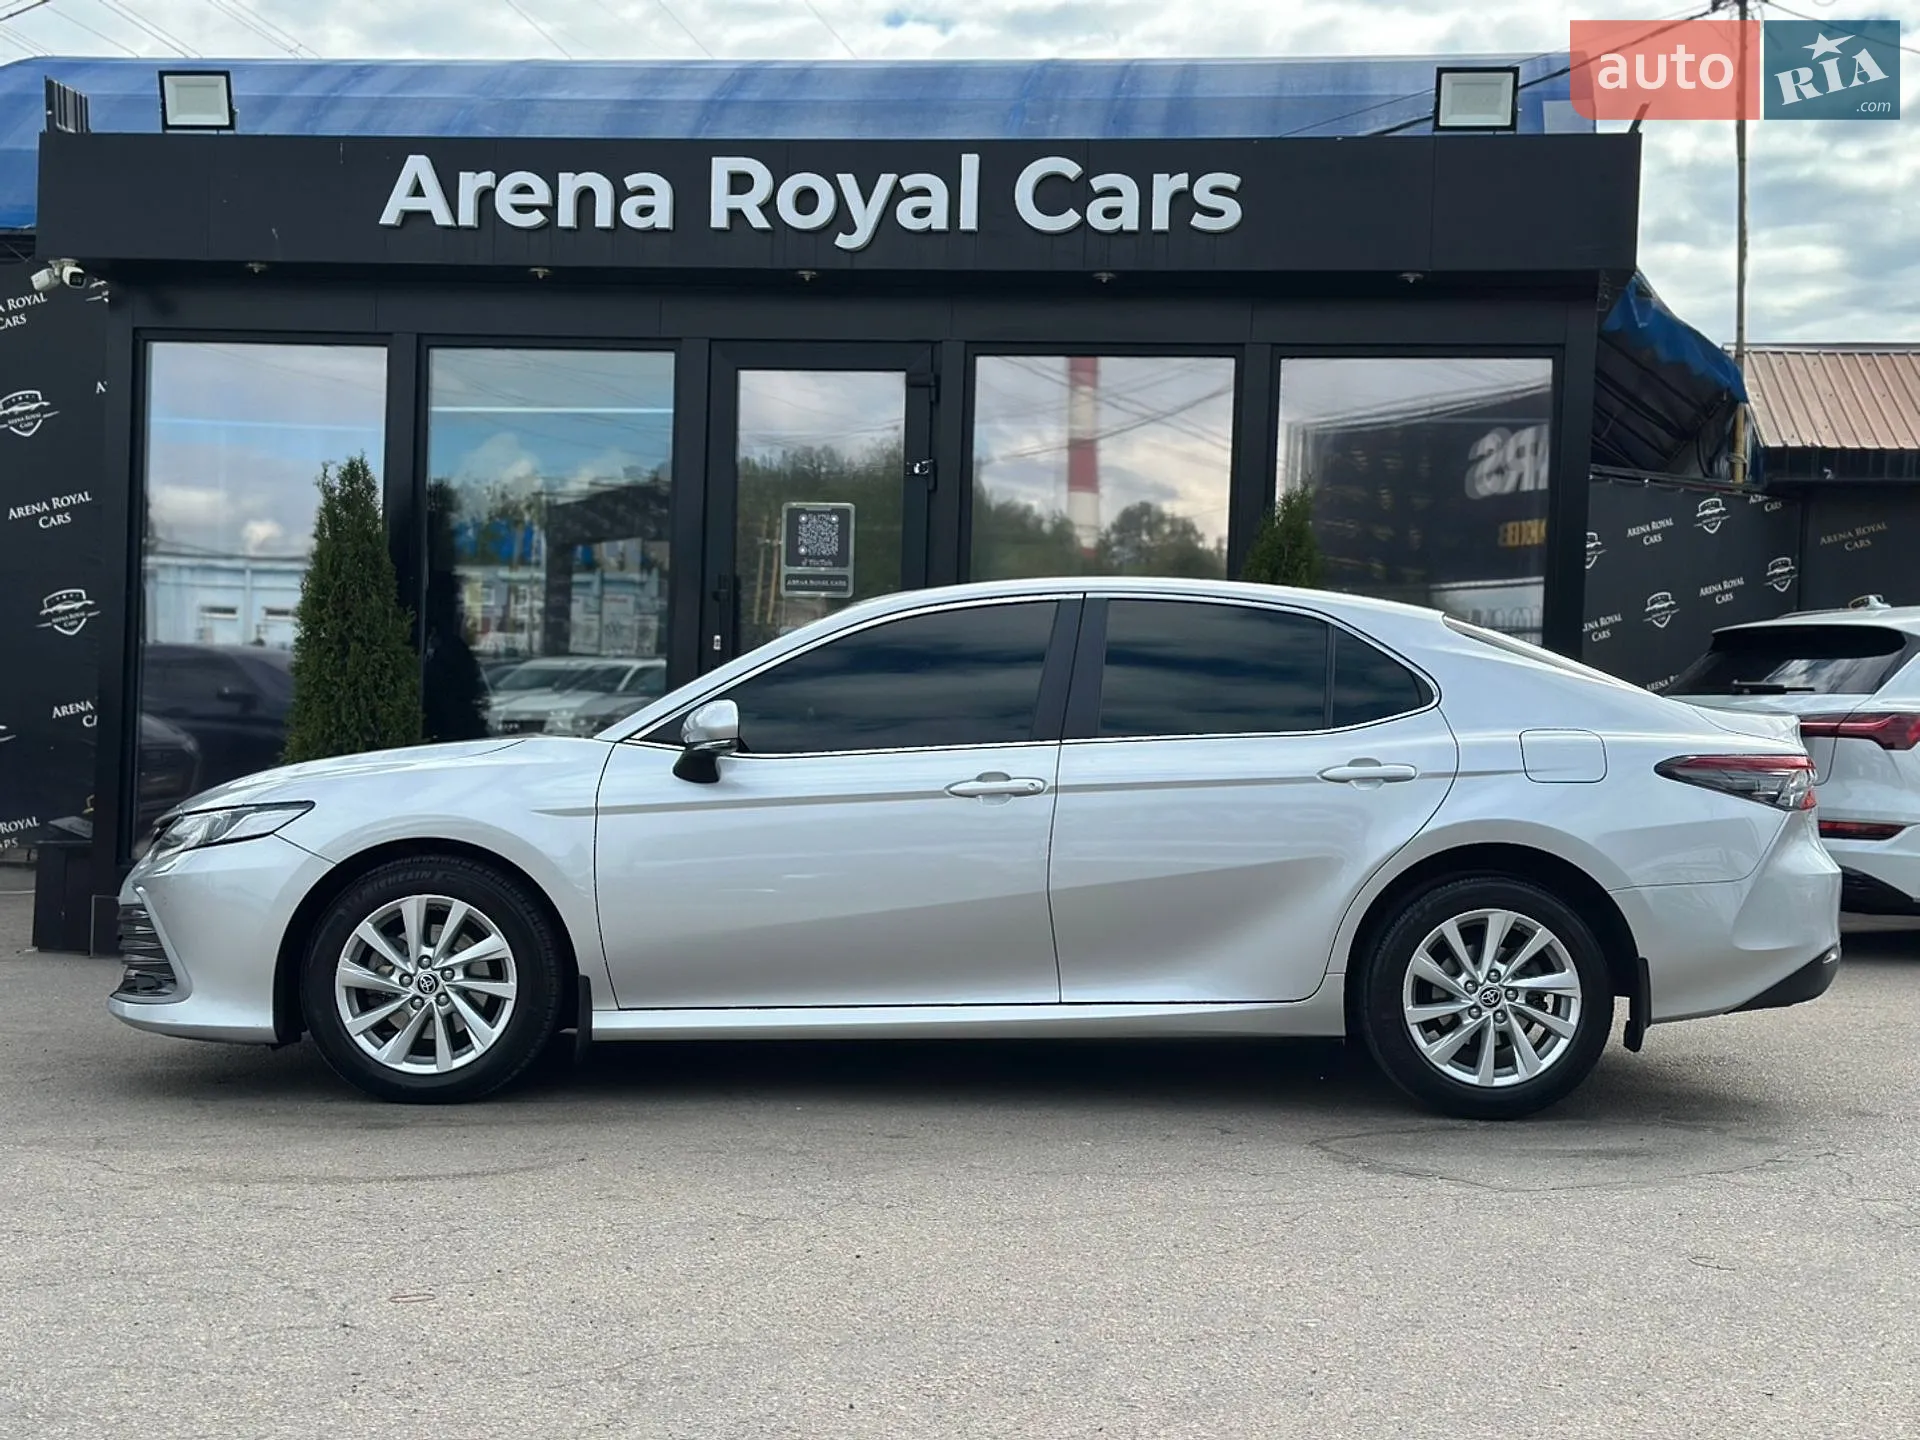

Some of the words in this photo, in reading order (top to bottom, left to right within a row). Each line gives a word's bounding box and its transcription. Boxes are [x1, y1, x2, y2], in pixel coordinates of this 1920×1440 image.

[378, 154, 676, 231] Arena
[709, 153, 980, 252] Royal
[1014, 155, 1244, 234] Cars
[7, 292, 48, 311] ROYAL
[8, 501, 50, 520] ARENA
[51, 491, 93, 510] ROYAL
[38, 512, 72, 529] CARS
[52, 700, 94, 719] ARENA
[0, 816, 40, 834] ROYAL
